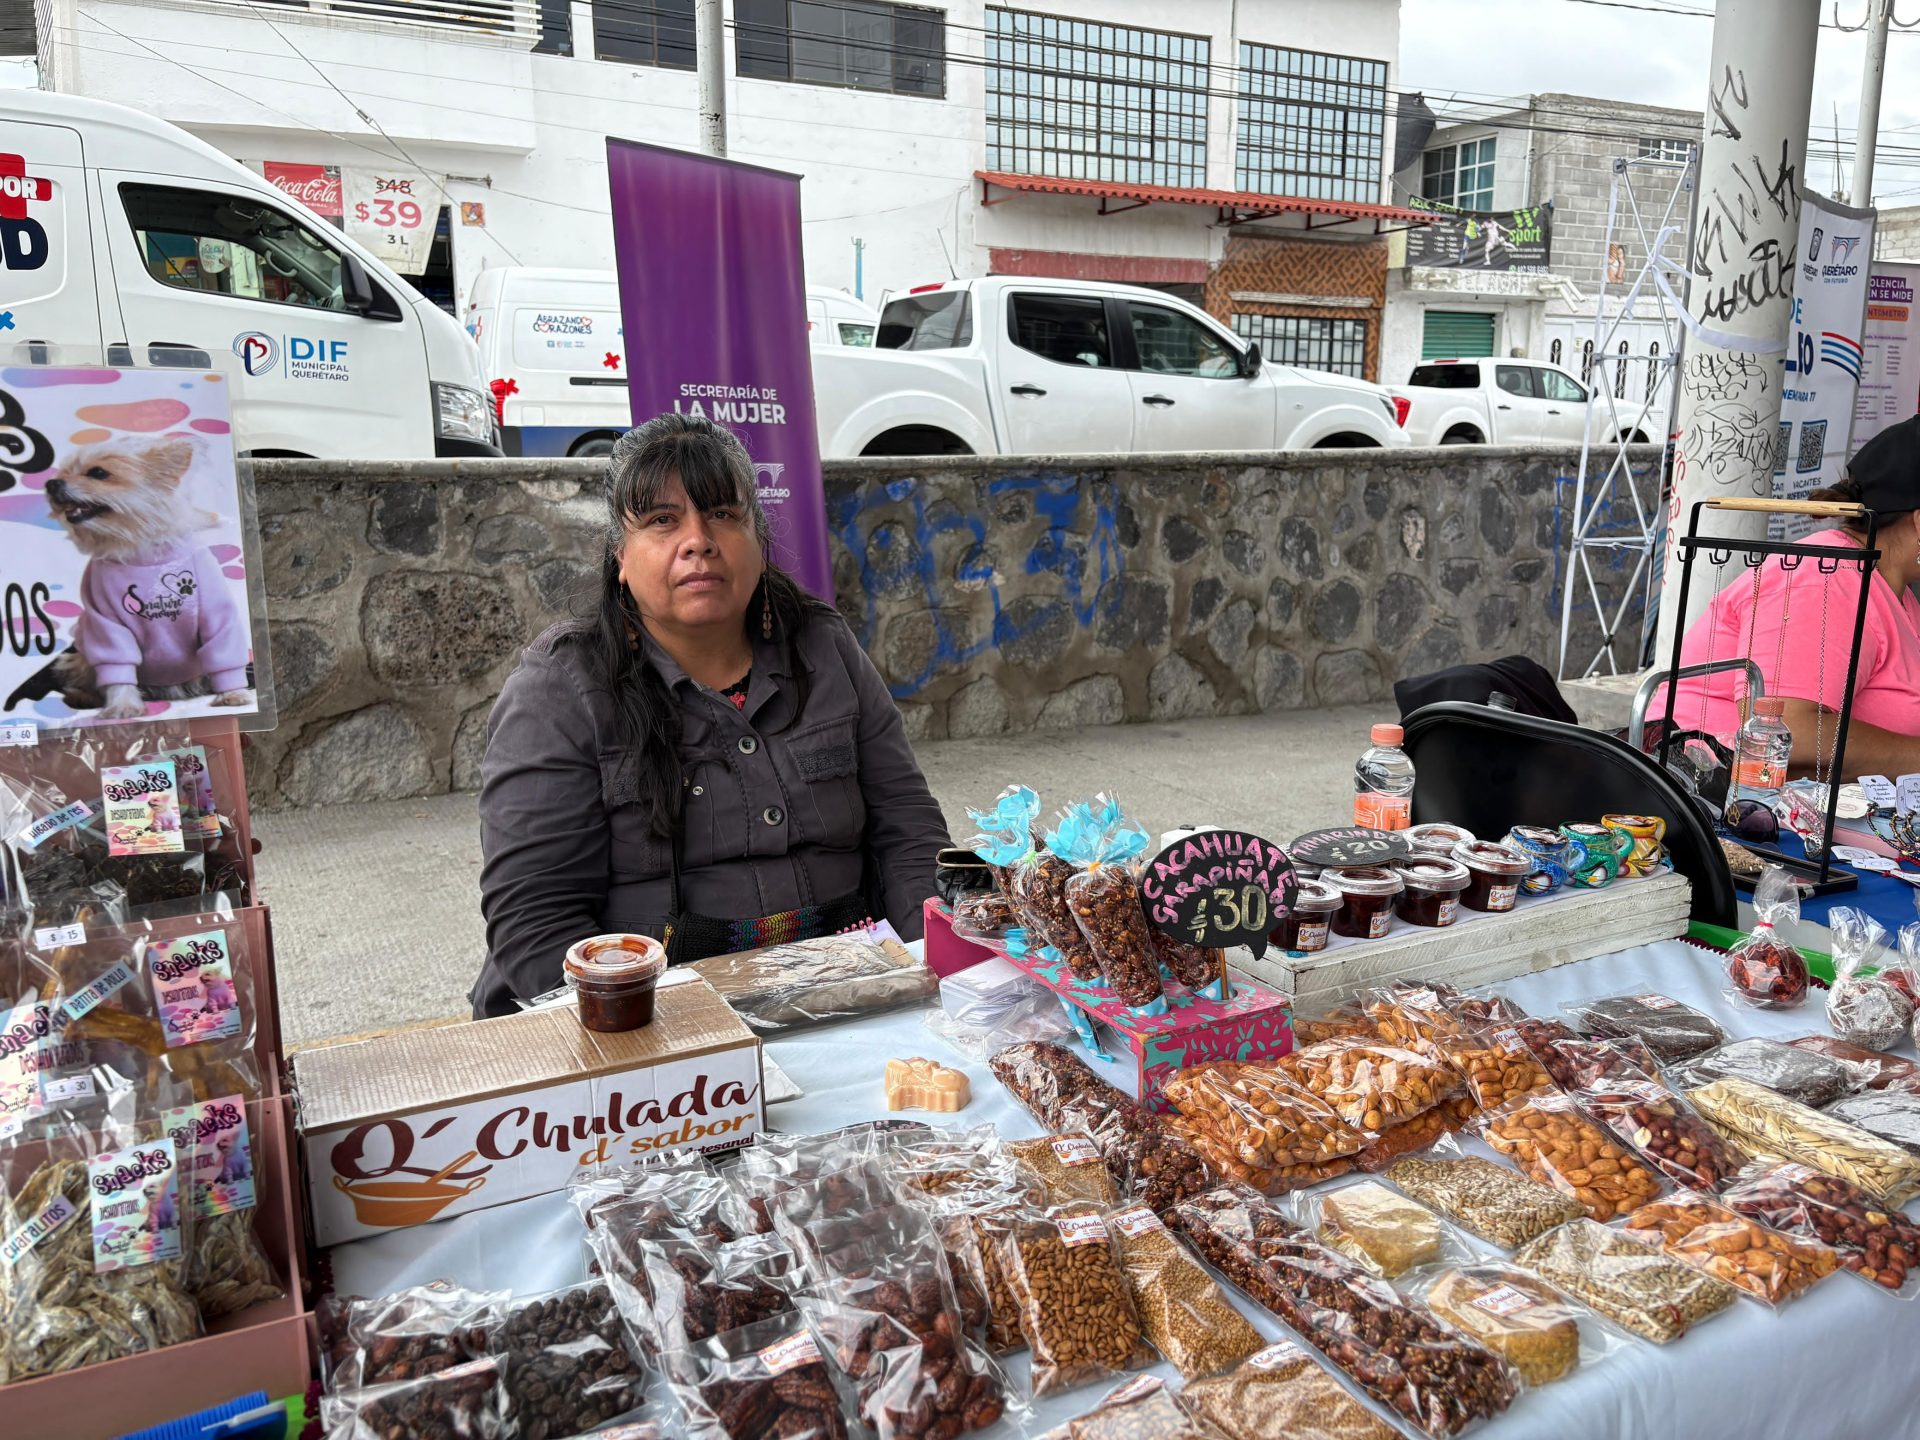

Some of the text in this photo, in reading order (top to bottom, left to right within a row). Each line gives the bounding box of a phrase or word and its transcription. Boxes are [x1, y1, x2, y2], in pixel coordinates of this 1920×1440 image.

[0, 176, 38, 199] OR
[376, 178, 412, 195] $48
[355, 199, 422, 229] $39
[387, 234, 409, 246] 3 L
[1509, 226, 1541, 246] sport
[1880, 290, 1889, 299] SE
[1891, 291, 1912, 300] MIDE
[290, 337, 348, 363] DIF
[291, 361, 349, 373] MUNICIPAL
[291, 369, 349, 382] QUERÉTARO
[680, 384, 777, 400] SECRETARÍA DE
[673, 400, 787, 425] LA MUJER
[0, 582, 56, 657] OS
[5, 730, 31, 740] $ 60
[1292, 827, 1401, 857] TAMARINDO
[1144, 833, 1299, 899] CACAHUATE
[1187, 884, 1268, 943] $30
[50, 930, 78, 942] $ 15
[76, 1081, 87, 1091] 30
[476, 1074, 759, 1161] Chulada
[630, 1113, 755, 1154] sabor
